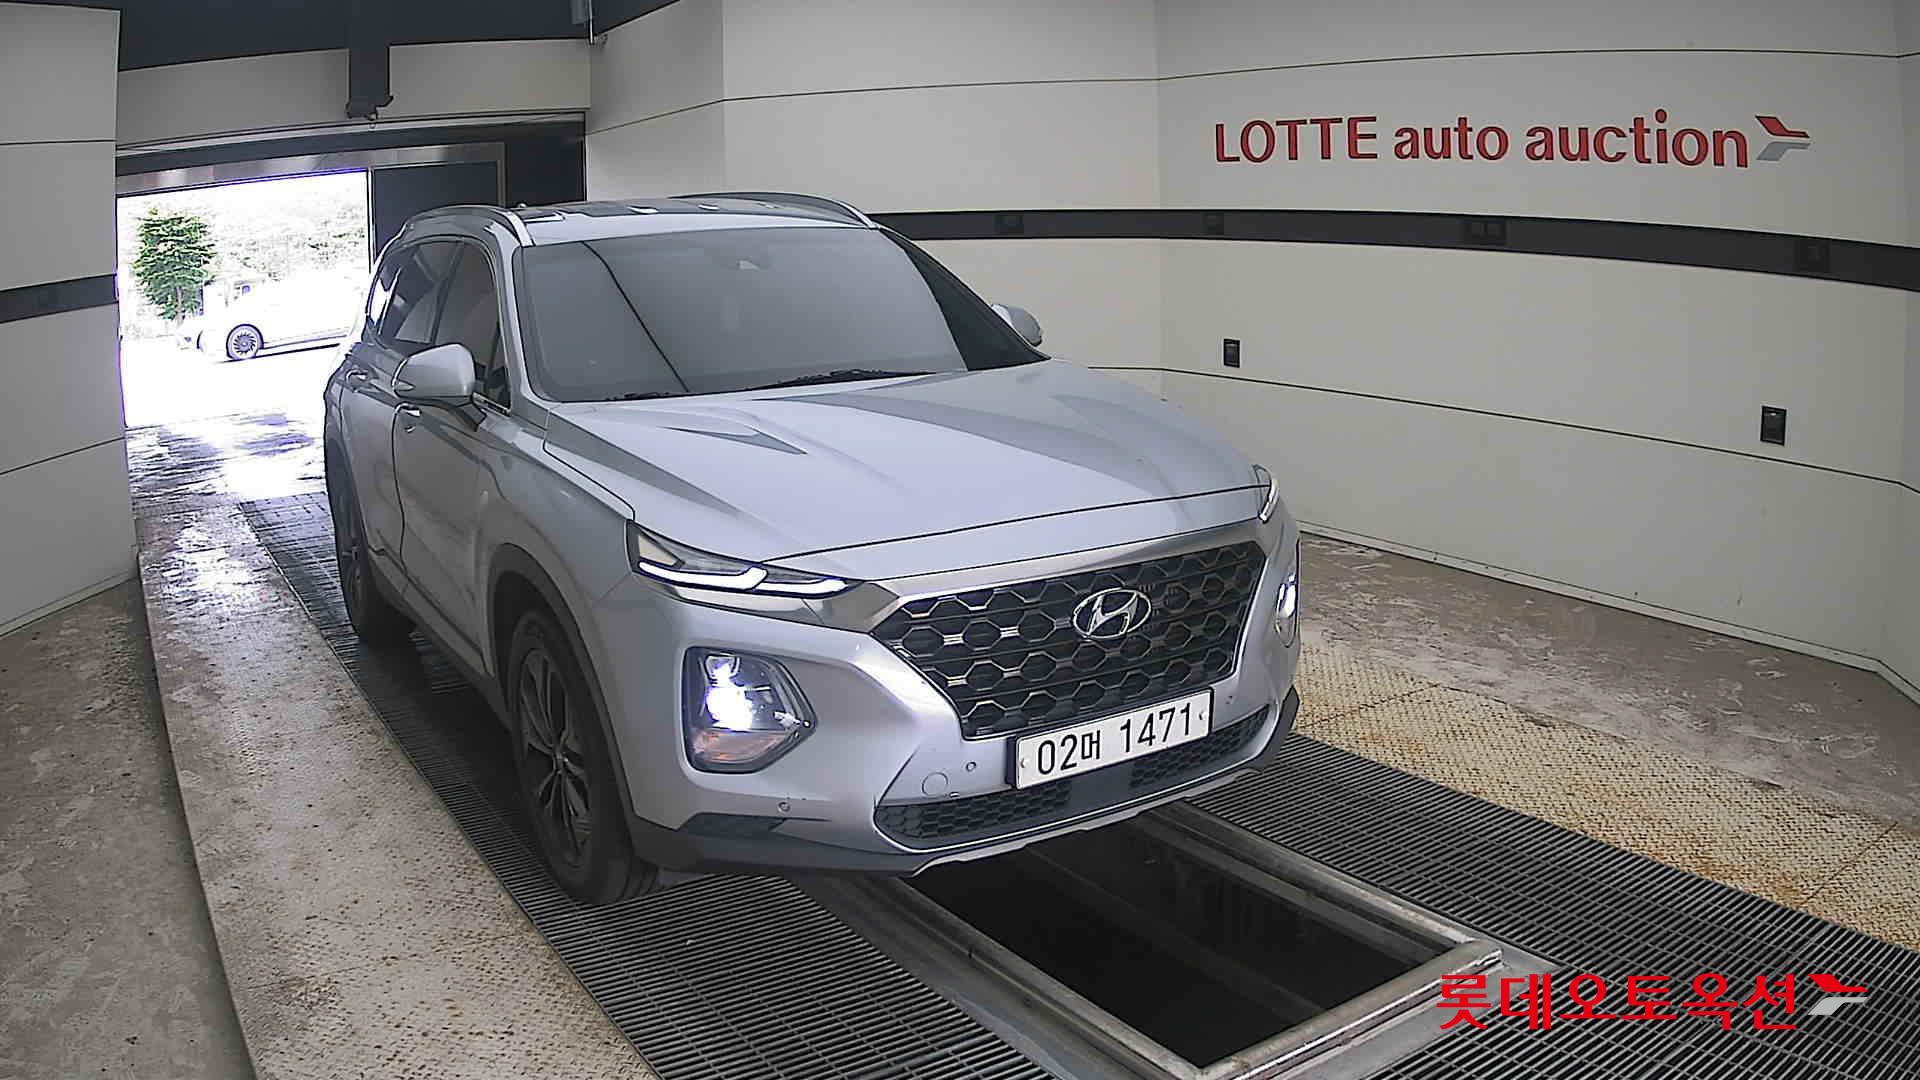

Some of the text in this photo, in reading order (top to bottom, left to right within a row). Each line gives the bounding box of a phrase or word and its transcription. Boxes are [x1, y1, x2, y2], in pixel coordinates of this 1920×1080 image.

[1215, 109, 1749, 168] LOTTE auto auction
[1037, 702, 1192, 775] 02머 1471
